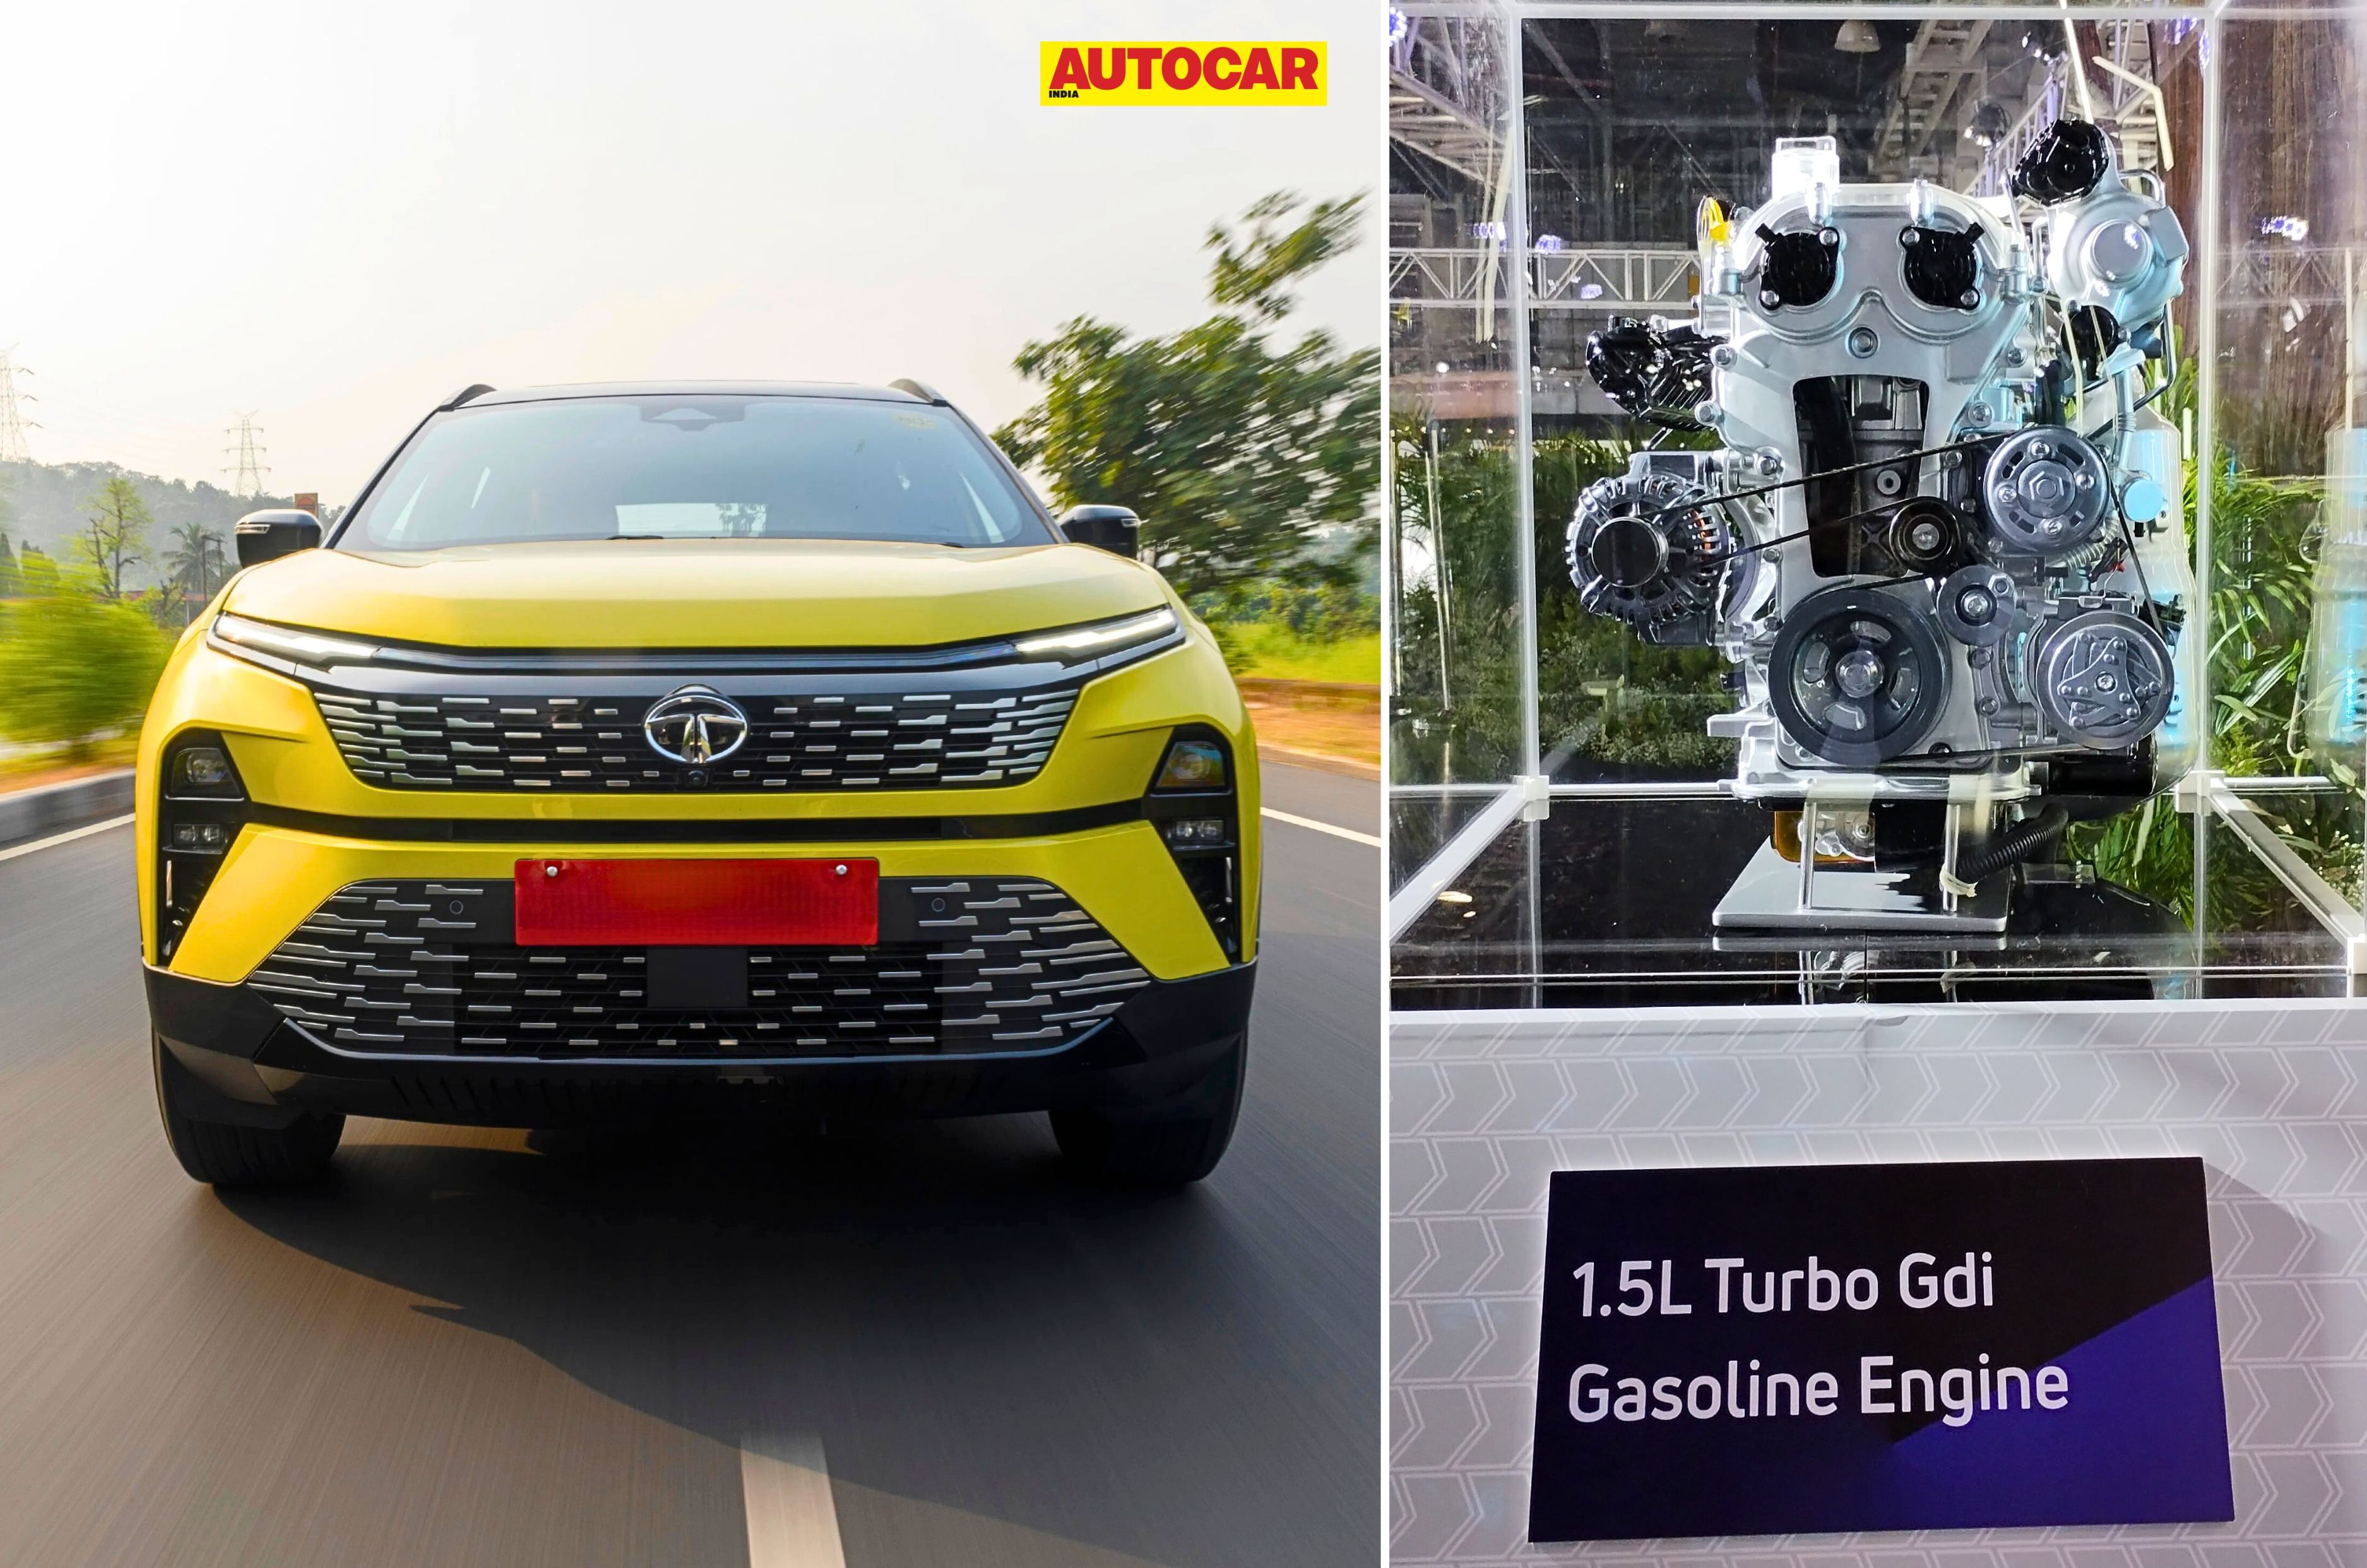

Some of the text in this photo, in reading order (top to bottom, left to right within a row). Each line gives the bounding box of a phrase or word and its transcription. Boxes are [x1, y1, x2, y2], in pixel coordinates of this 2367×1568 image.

[1573, 1251, 1994, 1317] 1.5L Turbo Gdi
[1568, 1353, 2069, 1428] Gasoline Engine
